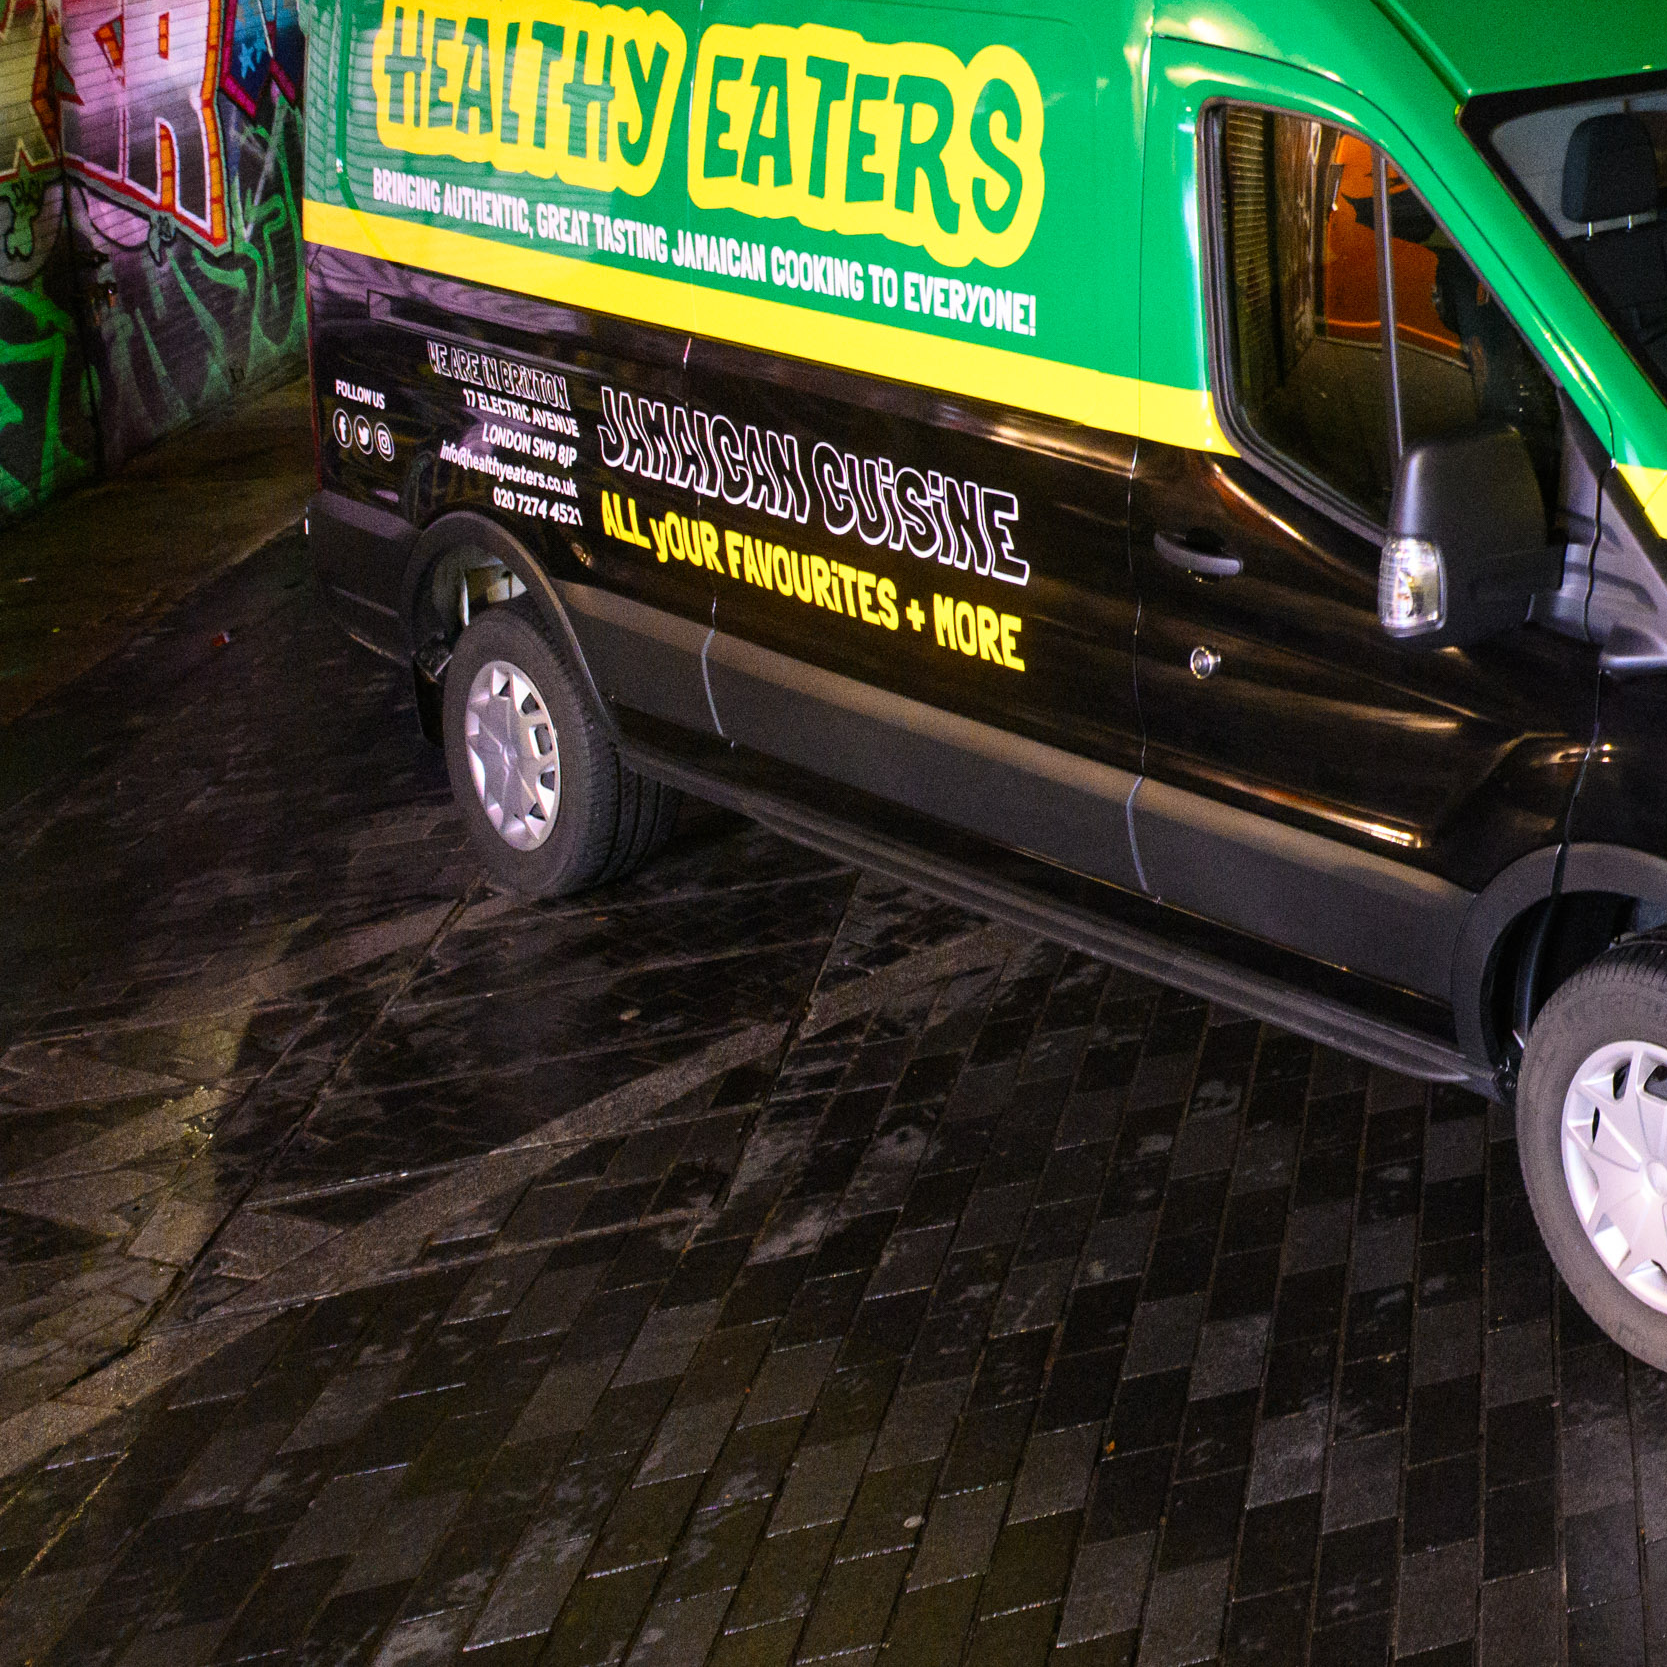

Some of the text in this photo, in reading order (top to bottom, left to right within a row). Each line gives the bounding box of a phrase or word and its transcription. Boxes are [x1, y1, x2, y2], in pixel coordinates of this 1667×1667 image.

[383, 5, 670, 167] HEALTHY
[703, 52, 1028, 235] EATERS
[373, 167, 1037, 337] BRINGING AUTHENTIC, GREAT TASTING JAMAICAN COOKING TO EVERYONE!
[426, 340, 452, 377] WE
[450, 348, 484, 386] ARE
[335, 379, 386, 410] FOLLOW US
[462, 388, 580, 438] 17 ELECTRIC AVENUE
[439, 440, 579, 498] info@healthyeaters.co.uk
[482, 422, 578, 468] LONDON SW9 8JP
[597, 386, 811, 524] JAMAICAN
[493, 486, 583, 527] 020 7274 4521
[601, 489, 652, 550] ALL
[932, 593, 1026, 672] MORE
